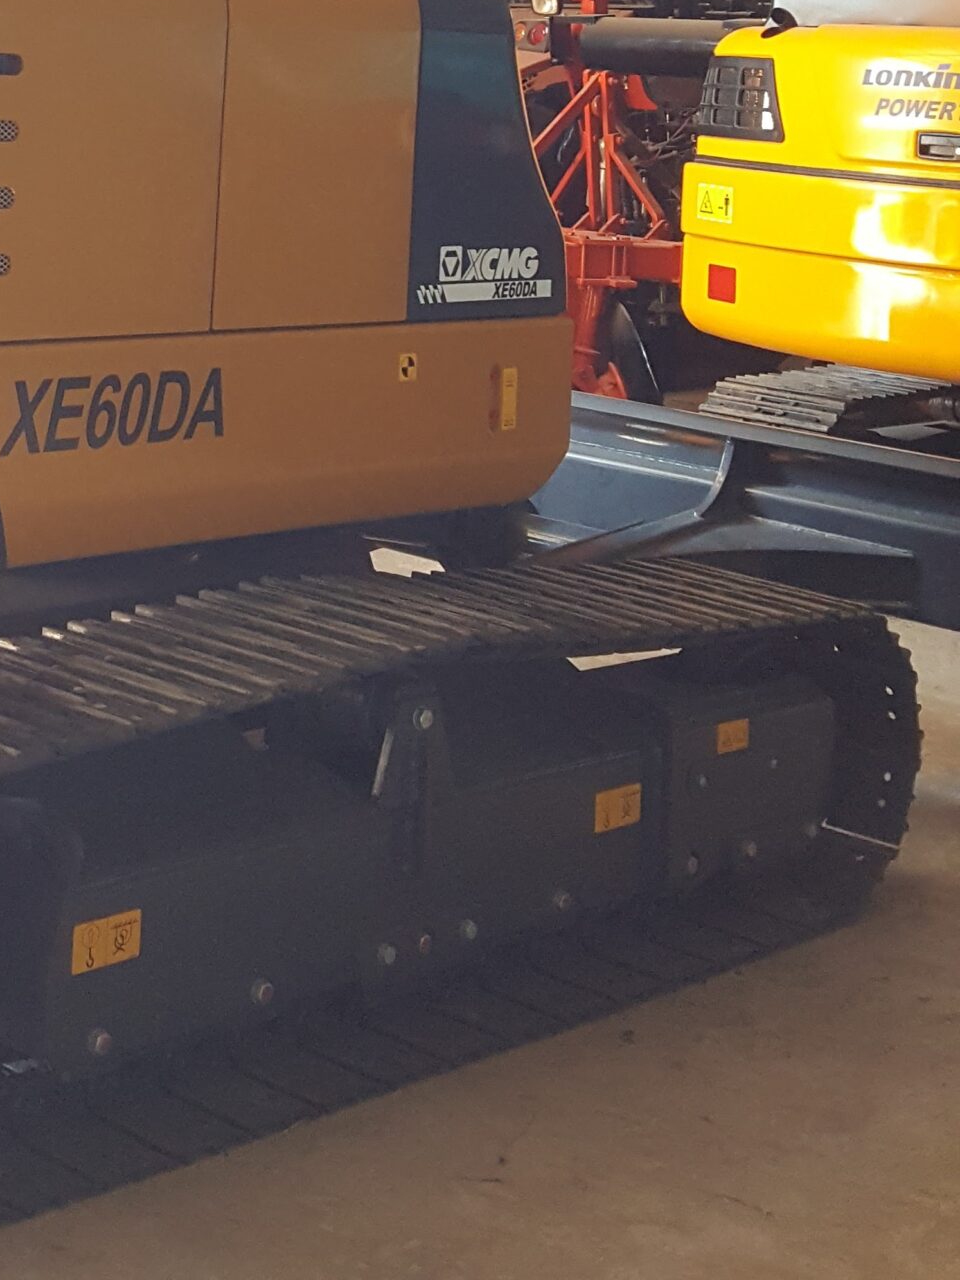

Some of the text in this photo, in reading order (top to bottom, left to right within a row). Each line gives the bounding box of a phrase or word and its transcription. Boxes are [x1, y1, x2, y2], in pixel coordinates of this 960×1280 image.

[874, 98, 957, 120] POWER
[463, 246, 539, 281] XCMG
[492, 281, 538, 300] XE60DA
